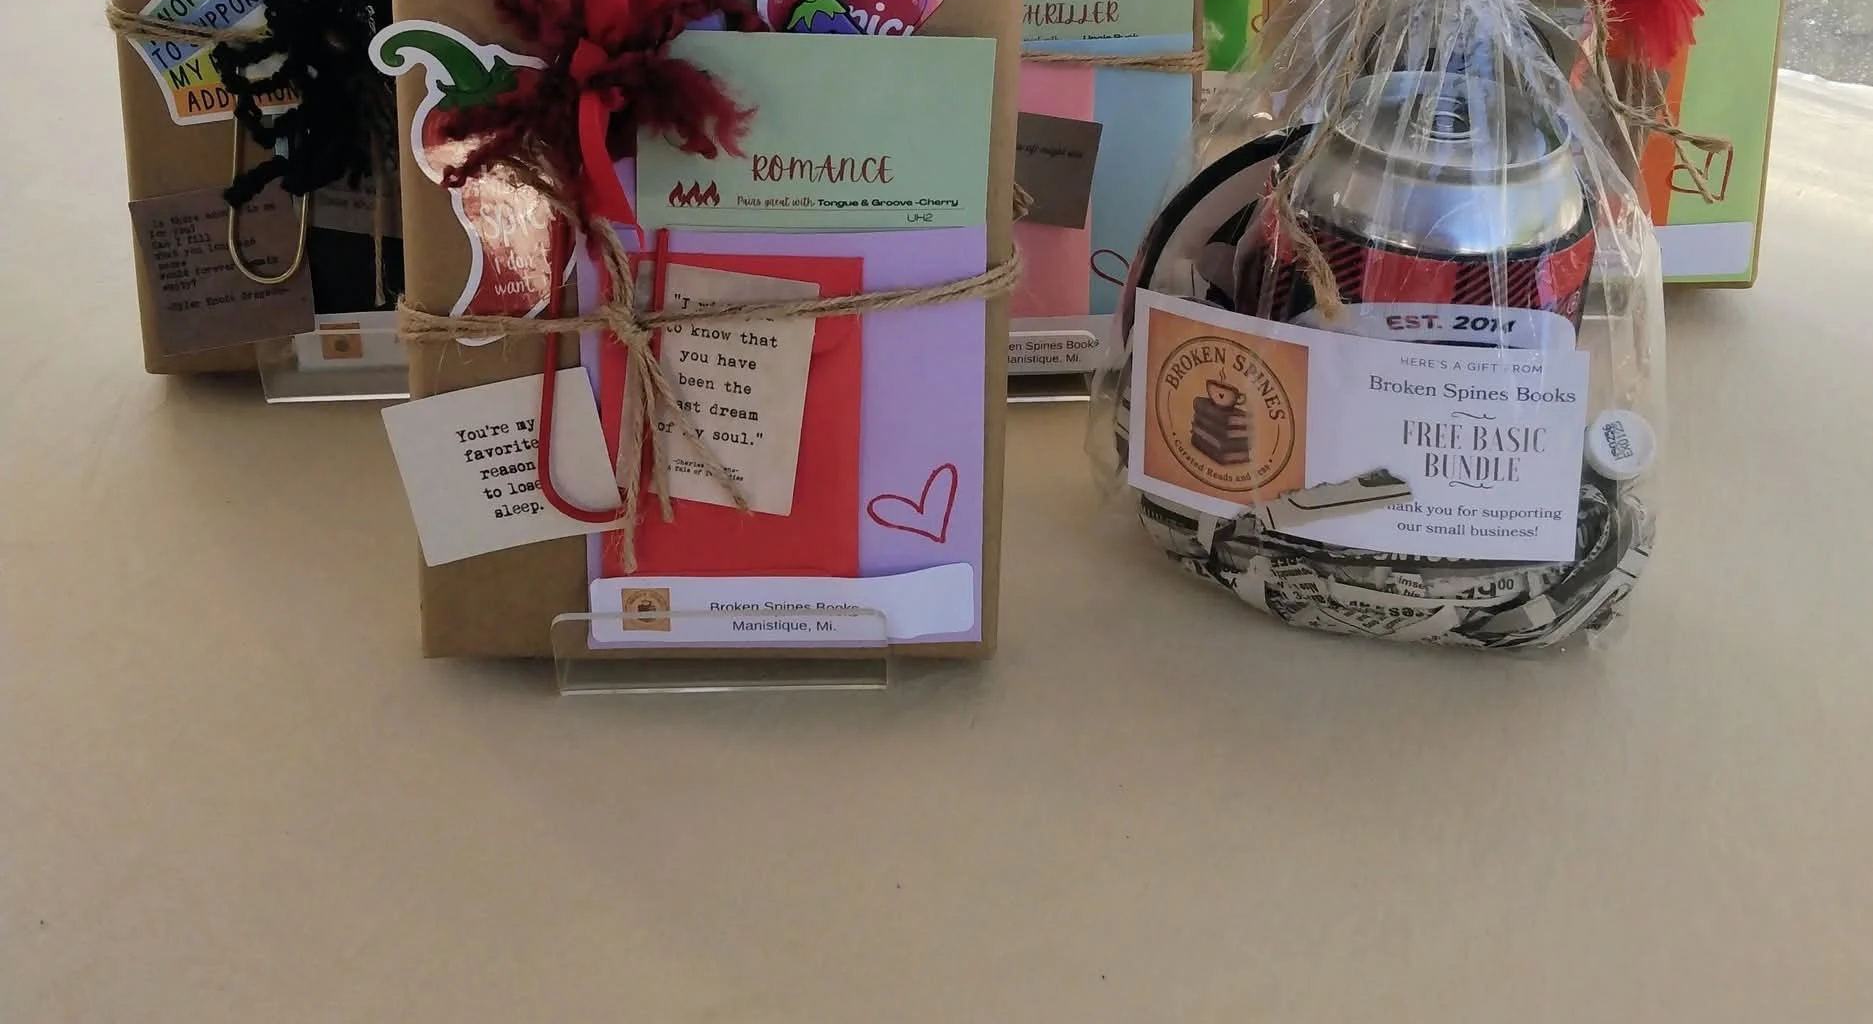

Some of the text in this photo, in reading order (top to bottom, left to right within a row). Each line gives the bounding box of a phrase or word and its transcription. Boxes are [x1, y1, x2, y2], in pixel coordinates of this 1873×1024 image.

[1023, 0, 1120, 26] HRILLER
[151, 39, 182, 69] TO
[169, 59, 204, 90] MY
[752, 154, 895, 184] ROMANCE
[817, 198, 857, 208] Tongue
[861, 198, 869, 207] &
[871, 198, 912, 207] Groove
[1386, 314, 1443, 331] EST.
[691, 324, 732, 341] know
[740, 331, 778, 348] that
[1025, 341, 1063, 352] Spines
[679, 349, 757, 370] you have
[1400, 356, 1543, 374] HERE'S A GIFT ROM
[679, 372, 752, 396] been the
[1165, 346, 1286, 422] BROKEN SPINES
[1369, 375, 1577, 404] Broken Spines Books
[677, 399, 758, 421] ast dream
[456, 418, 535, 443] You're my
[657, 422, 675, 433] of
[712, 430, 763, 446] soul."
[1402, 419, 1547, 453] FREE BASIC
[464, 437, 540, 463] favorite
[480, 461, 536, 480] reason
[1425, 452, 1520, 482] BUNDLE
[483, 479, 543, 499] to lose
[494, 500, 544, 518] sleep.
[1426, 506, 1453, 517] you
[1457, 505, 1478, 517] for
[1482, 507, 1562, 521] supporting
[1397, 522, 1539, 537] our small business!
[732, 620, 837, 633] Manistique, Mi.
